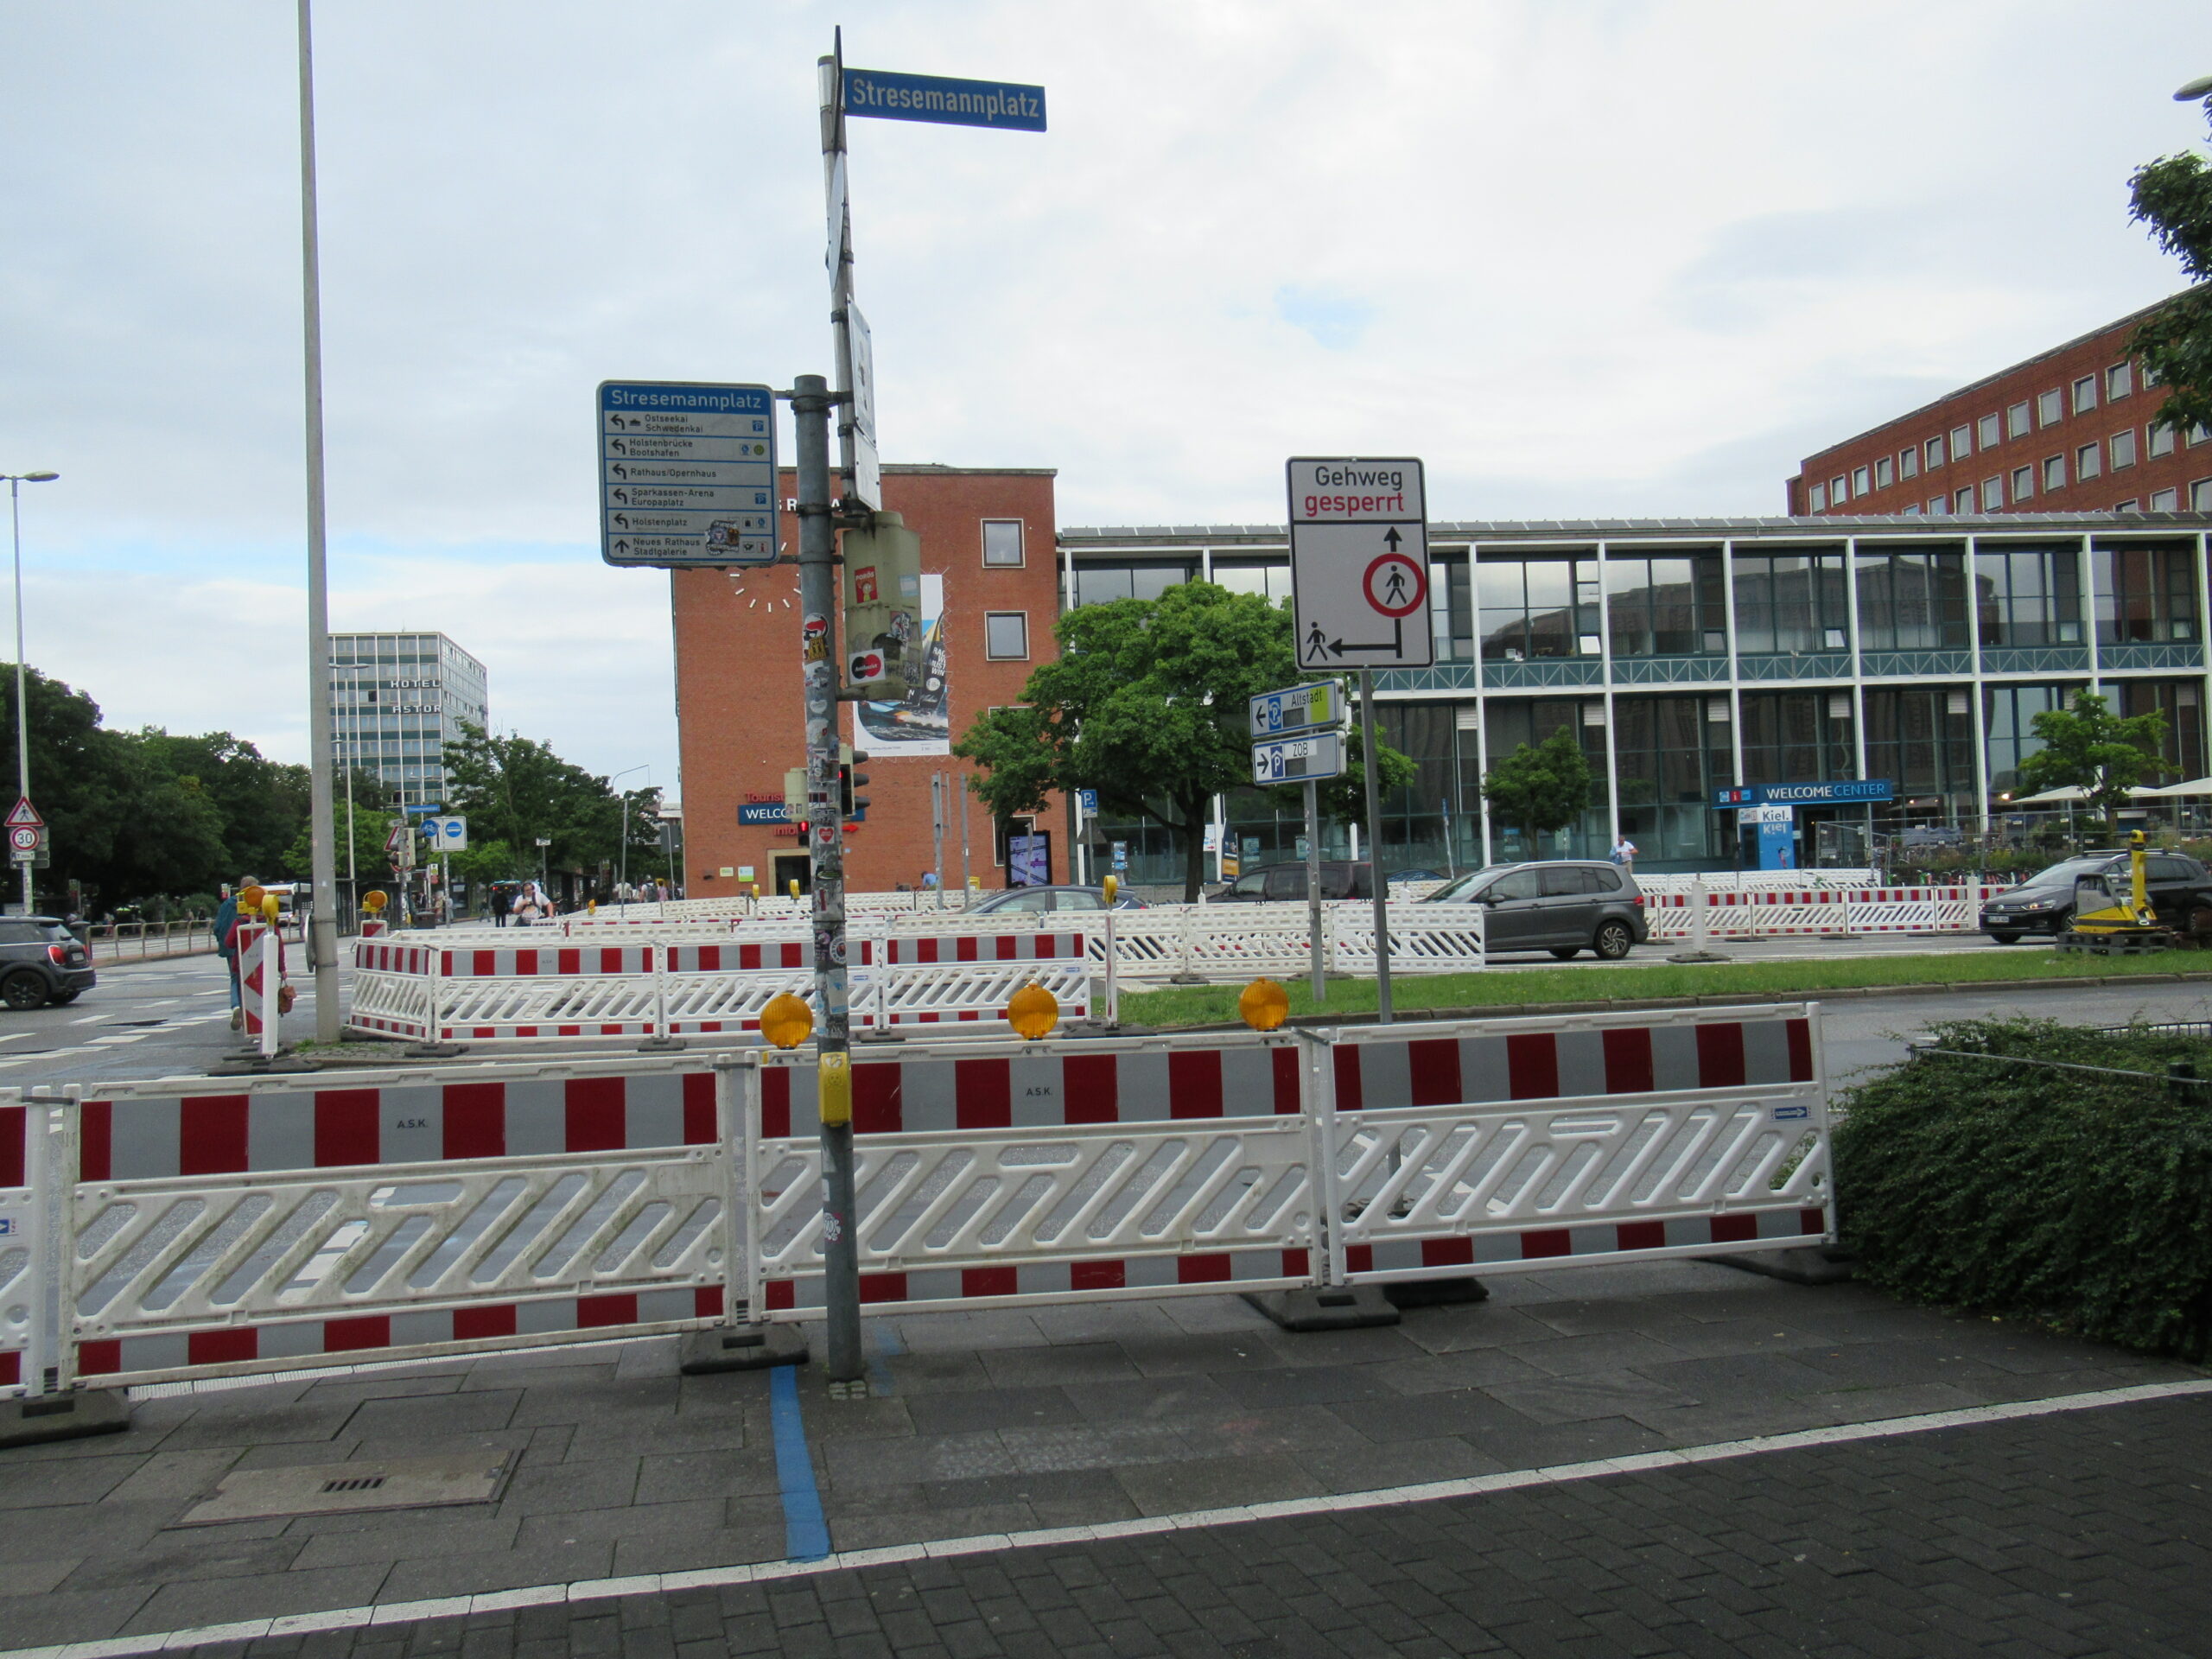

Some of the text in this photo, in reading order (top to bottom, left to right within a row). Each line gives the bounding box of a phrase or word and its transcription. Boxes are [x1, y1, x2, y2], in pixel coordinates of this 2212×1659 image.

[853, 78, 1039, 121] Stresemannplatz
[612, 390, 761, 410] Stresemannplatz
[645, 414, 688, 423] Ostseekai
[645, 423, 703, 433] Schwedenkai
[629, 438, 693, 448] Holstenbrücke
[630, 448, 680, 457] Bootshafen
[631, 467, 717, 479] Rathaus/Opernhaus
[1315, 466, 1402, 491] Gehweg
[632, 488, 715, 499] Sparkassen-Arena
[632, 498, 684, 508] Europaplatz
[1305, 493, 1404, 517] gesperrt
[632, 518, 688, 528] Holstenplatz
[633, 537, 701, 546] Neues Rathaus
[633, 547, 688, 556] Stadtgalerie
[1291, 690, 1323, 707] Altstadt
[1293, 742, 1308, 757] ZOB
[1766, 785, 1833, 800] WELCOME
[1834, 784, 1885, 797] CENTER
[747, 809, 787, 819] WELCO
[1763, 810, 1789, 821] Kiel.
[17, 833, 33, 844] 30
[397, 1118, 429, 1129] A.S.K.
